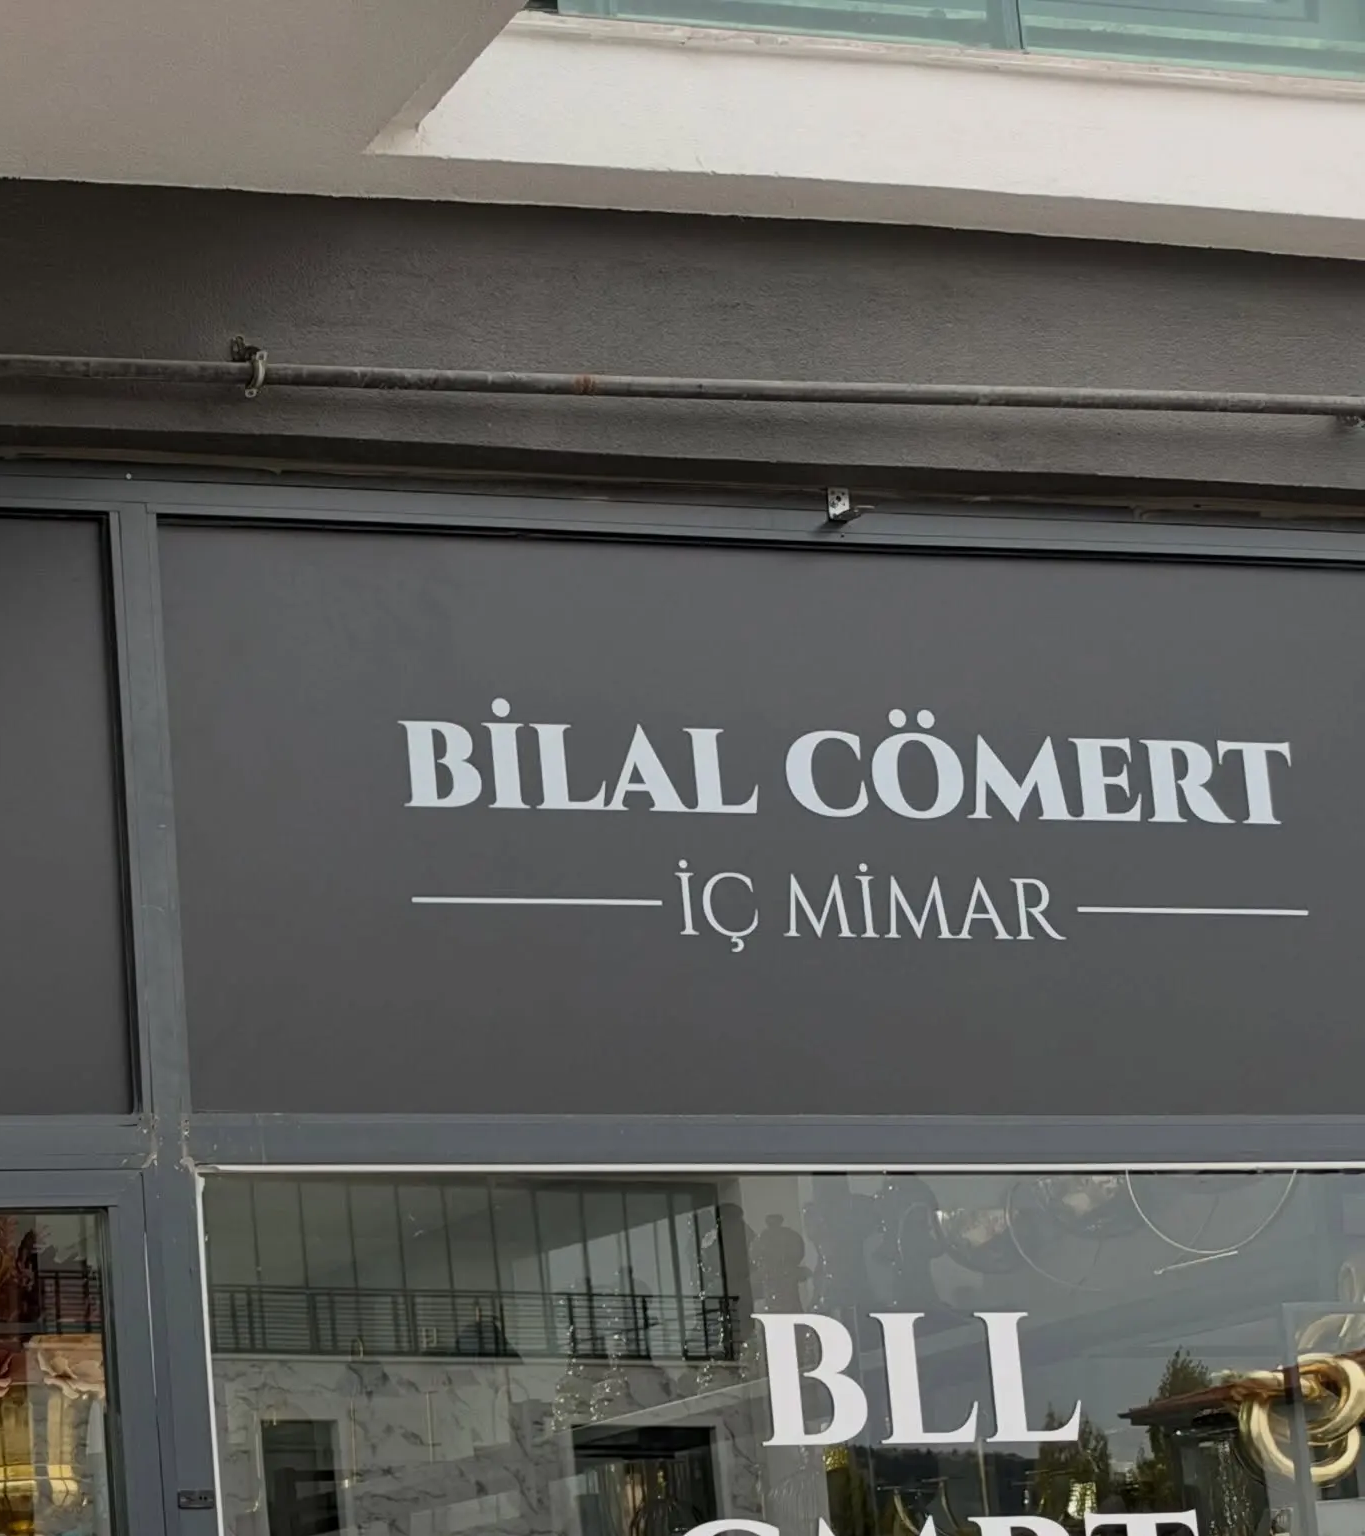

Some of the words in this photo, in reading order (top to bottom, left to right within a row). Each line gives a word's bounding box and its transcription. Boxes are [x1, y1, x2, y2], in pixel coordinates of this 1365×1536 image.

[397, 698, 760, 814] BİLAL
[784, 708, 1292, 825] CÖMERT
[675, 859, 760, 953] İÇ
[783, 863, 1067, 940] MİMAR
[750, 1311, 1082, 1447] BLL
